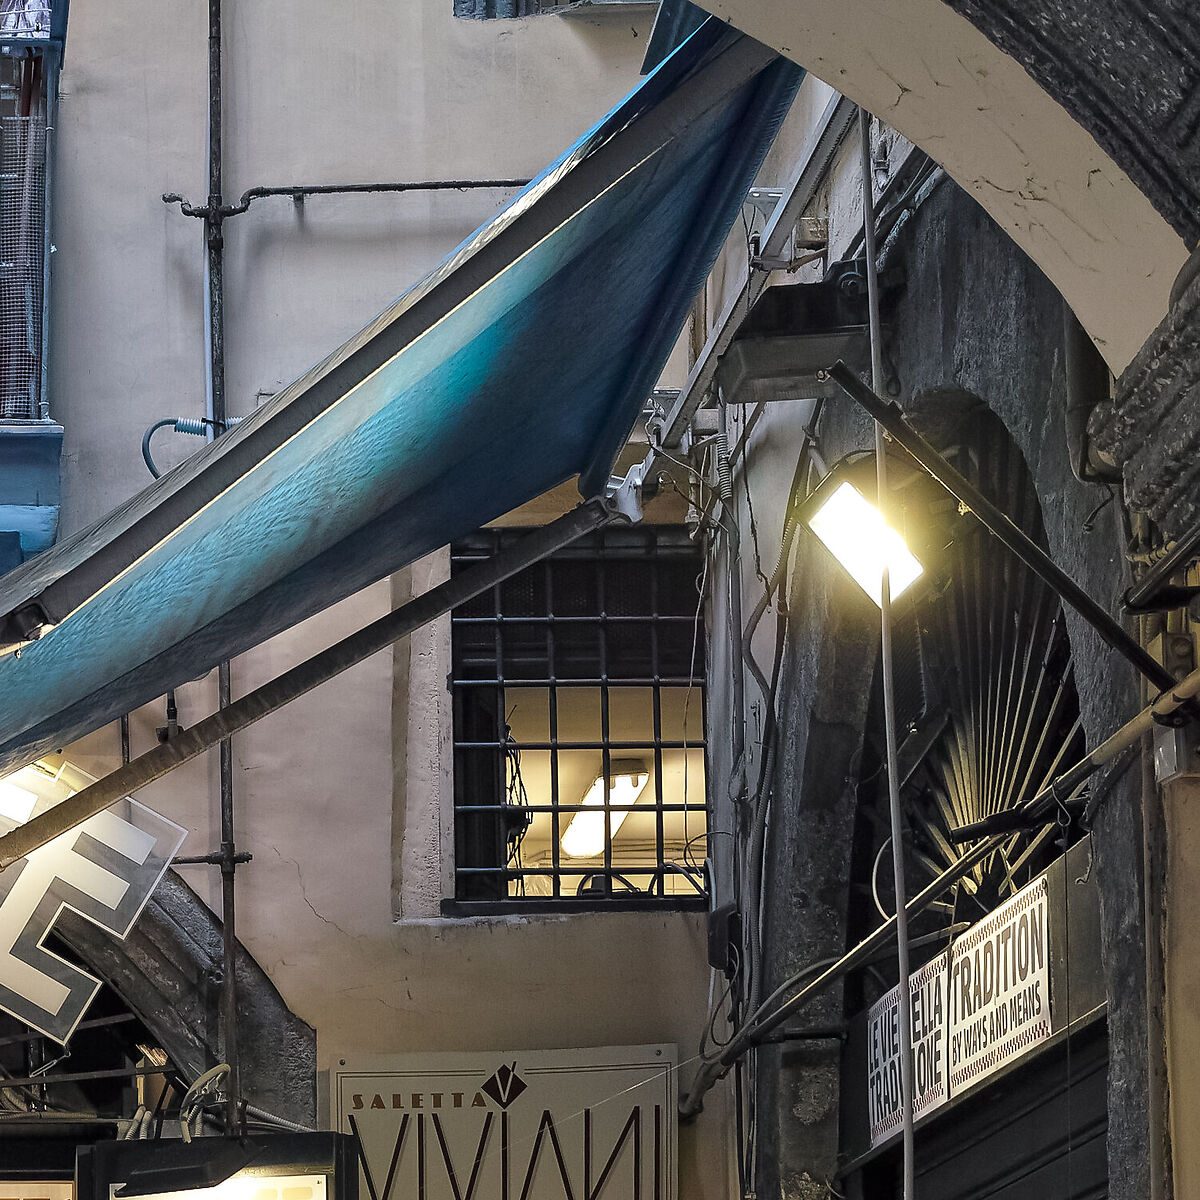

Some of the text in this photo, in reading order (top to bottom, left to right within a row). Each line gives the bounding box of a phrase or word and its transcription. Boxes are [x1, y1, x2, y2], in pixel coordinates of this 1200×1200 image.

[952, 902, 1044, 1026] TRADITION
[880, 1004, 899, 1063] VIE
[911, 975, 943, 1044] ELLA
[952, 980, 1042, 1067] BY WAYS AND MEANS
[352, 1092, 487, 1110] SALETTA
[870, 1029, 942, 1126] TRADIONE
